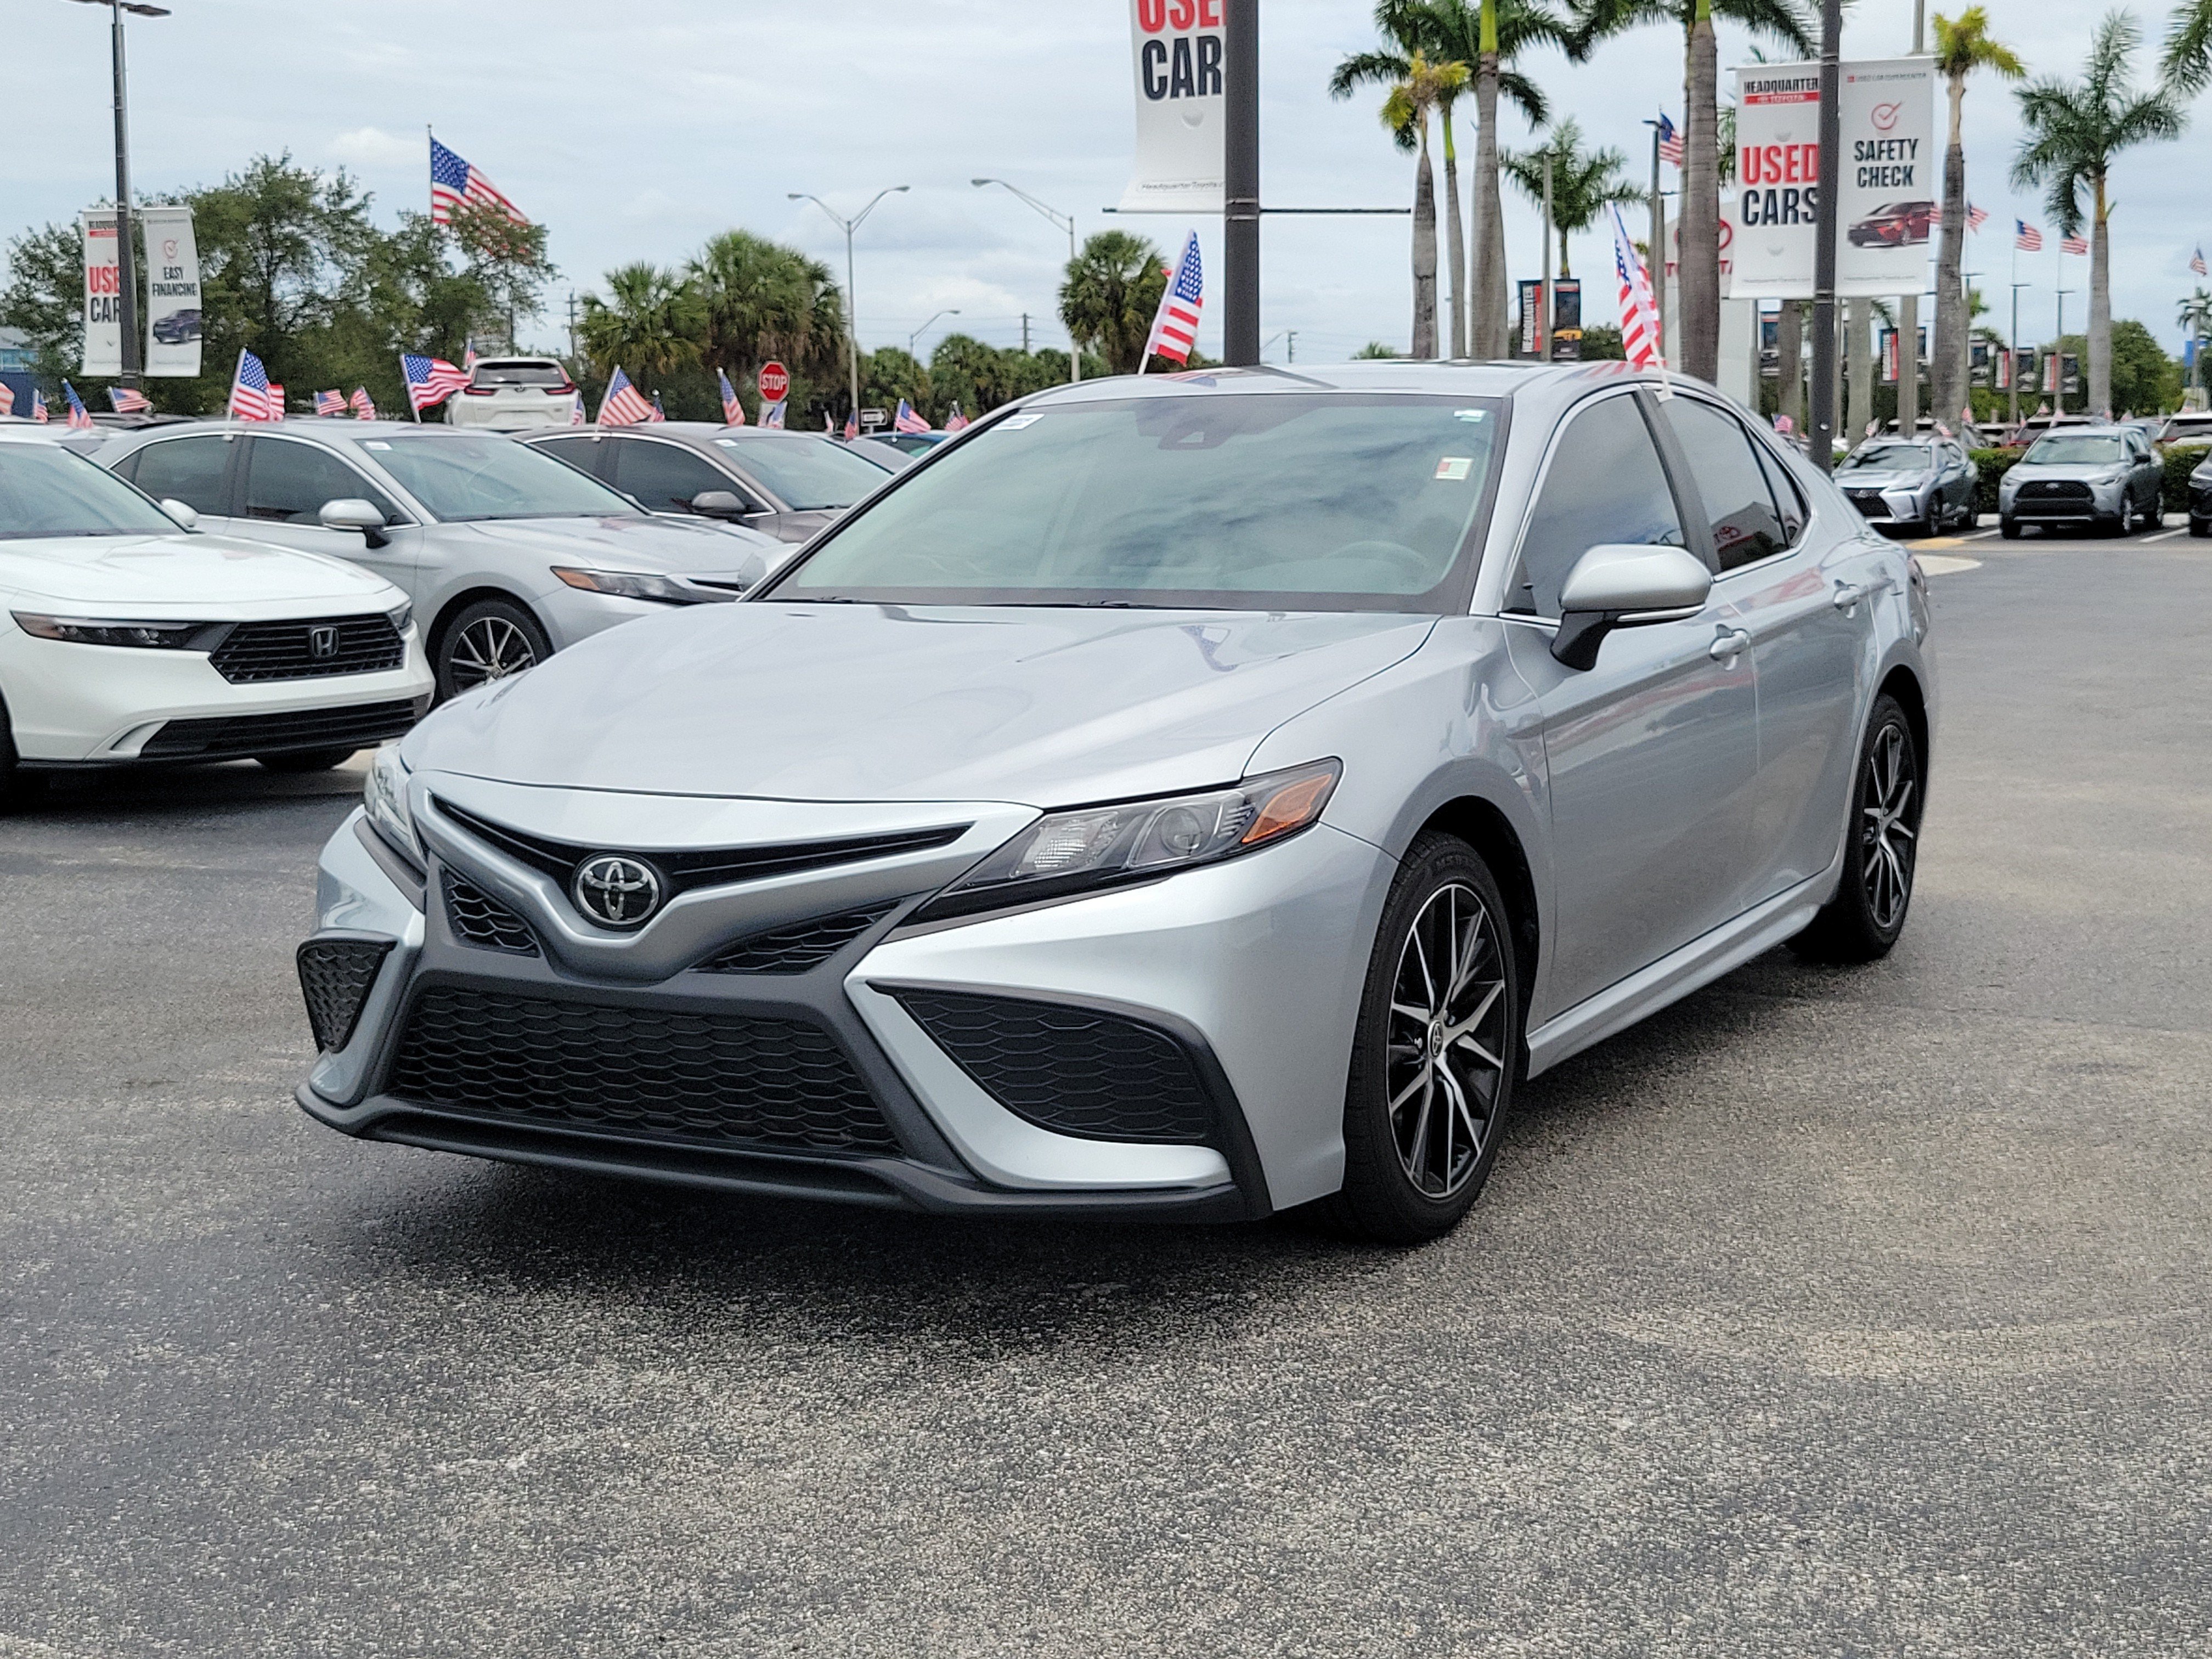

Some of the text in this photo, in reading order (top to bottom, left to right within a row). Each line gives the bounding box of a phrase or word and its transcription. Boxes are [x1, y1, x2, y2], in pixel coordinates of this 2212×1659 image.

[1854, 138, 1918, 161] SAFETY
[1742, 144, 1819, 185] USED
[1857, 165, 1914, 188] CHECK
[1741, 187, 1819, 226] CARS
[163, 267, 184, 280] EASY
[761, 374, 788, 391] STOP
